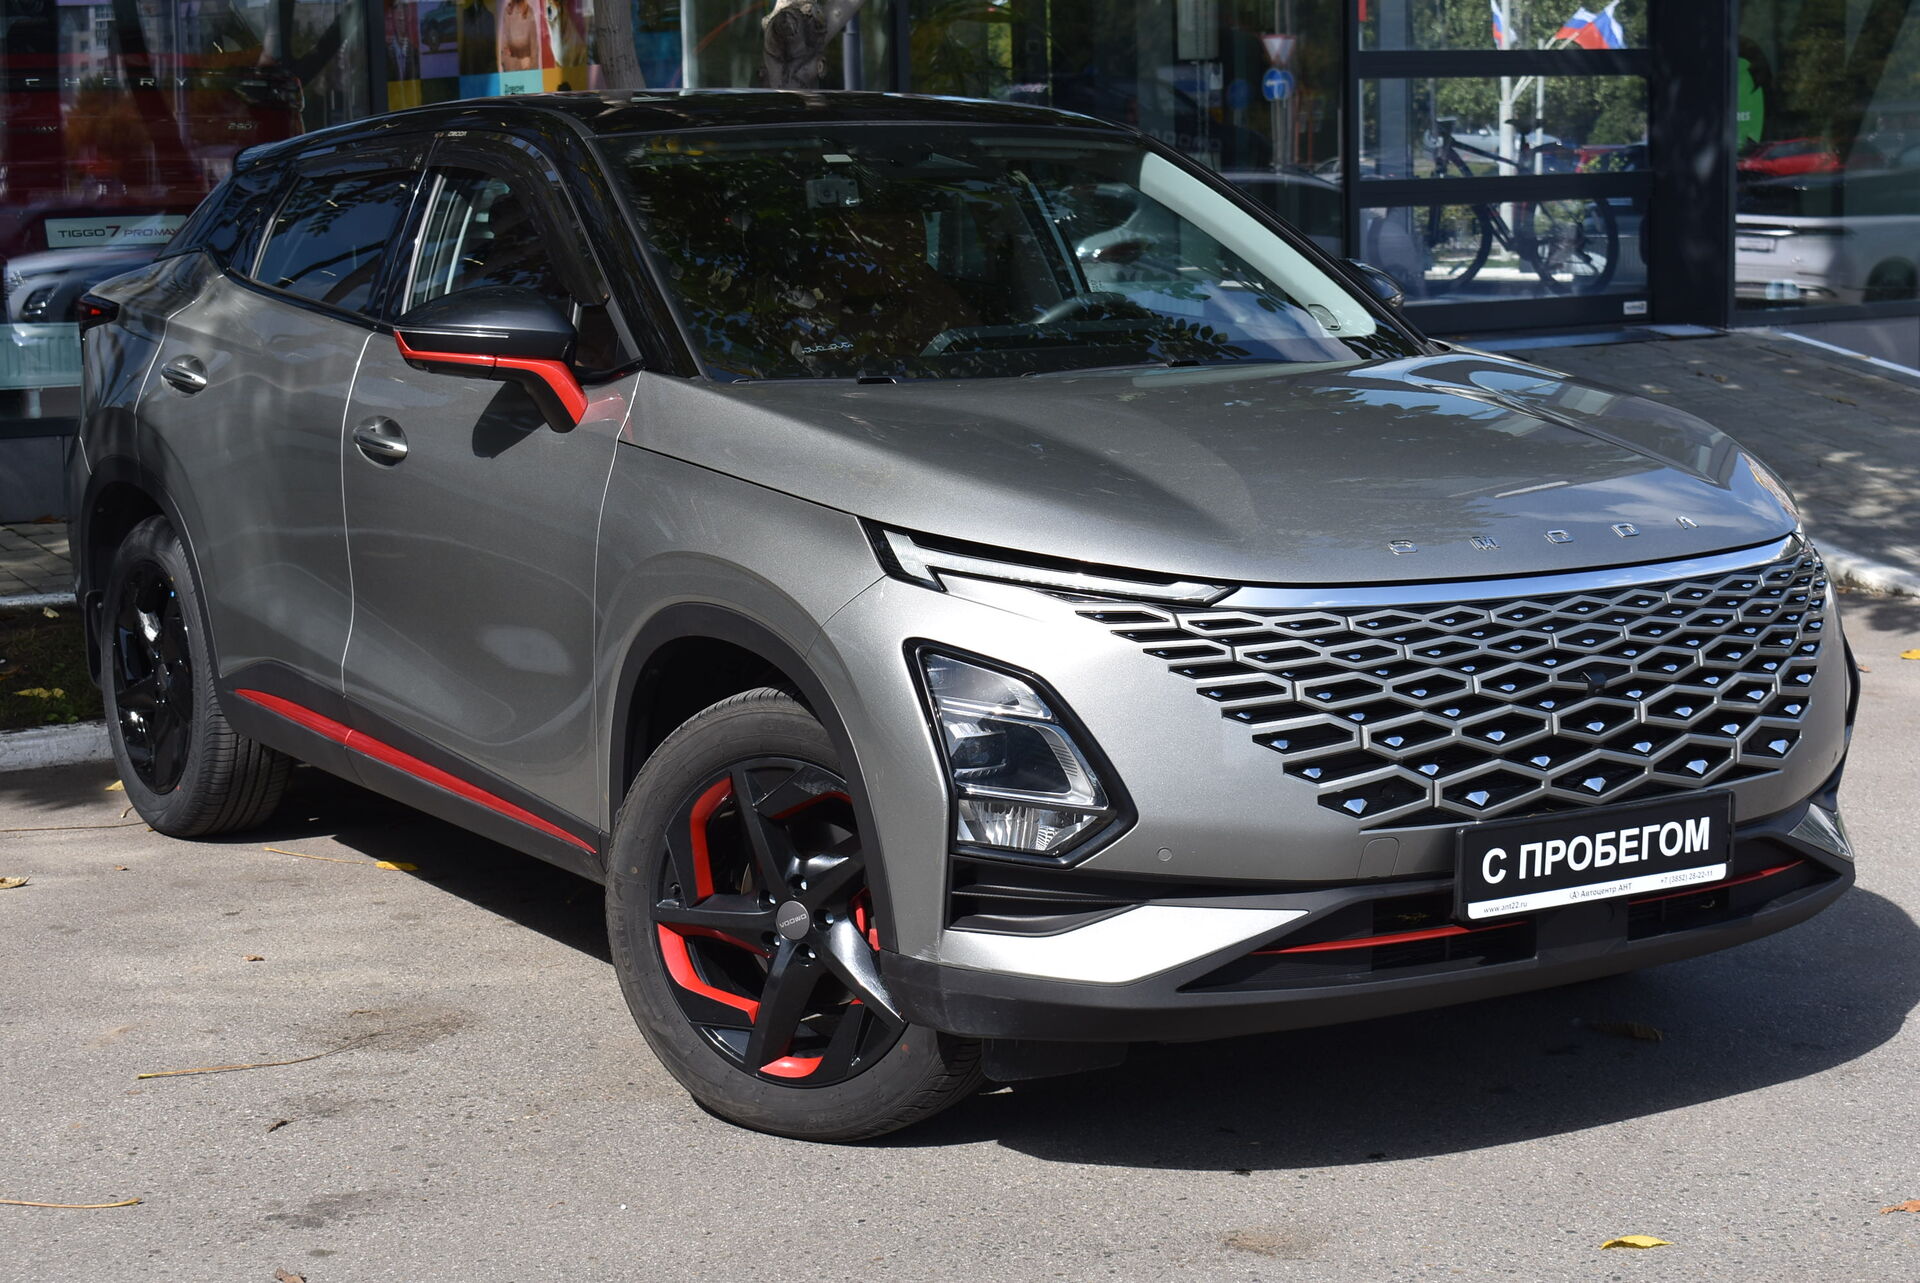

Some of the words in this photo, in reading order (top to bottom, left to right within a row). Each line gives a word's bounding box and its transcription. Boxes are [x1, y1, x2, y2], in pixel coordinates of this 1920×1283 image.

[57, 229, 105, 239] TIGGO
[106, 225, 121, 238] 7
[1482, 847, 1507, 884] С
[1518, 816, 1710, 880] ПРОБЕГОМ
[1581, 886, 1617, 897] Автоцентр
[1618, 882, 1632, 891] АНТ
[1483, 901, 1528, 913] www.ant22.ru
